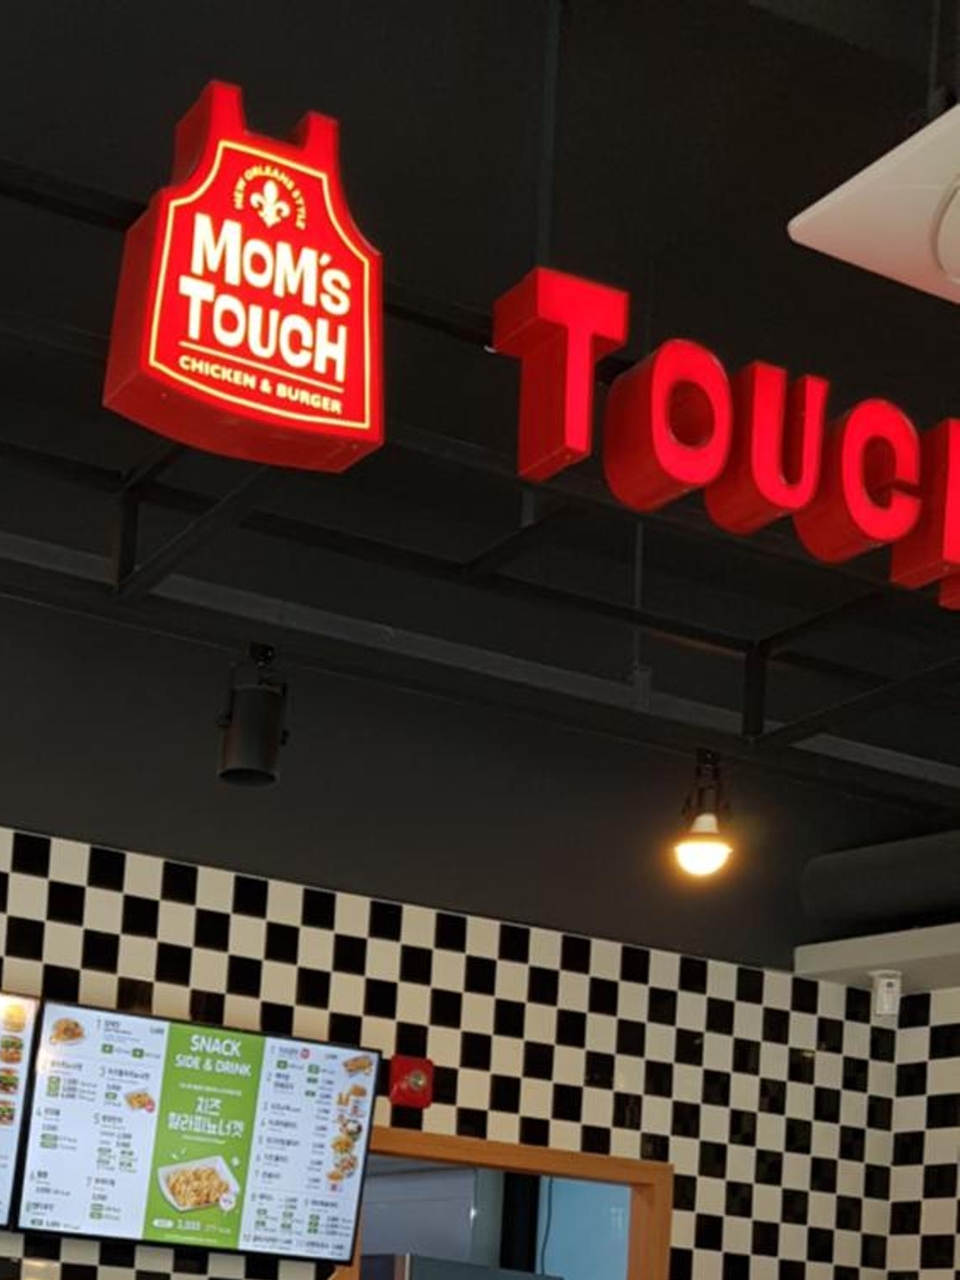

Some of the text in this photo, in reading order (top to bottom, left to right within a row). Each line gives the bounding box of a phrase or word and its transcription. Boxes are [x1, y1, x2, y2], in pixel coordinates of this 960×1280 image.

[233, 165, 307, 231] NEW ORLEANS STYLE
[178, 275, 348, 382] TOUCH
[178, 353, 343, 415] CHICKEN & BURGER
[174, 1053, 201, 1070] SIDE
[214, 1059, 252, 1077] DRINK
[189, 1034, 242, 1057] SNACK
